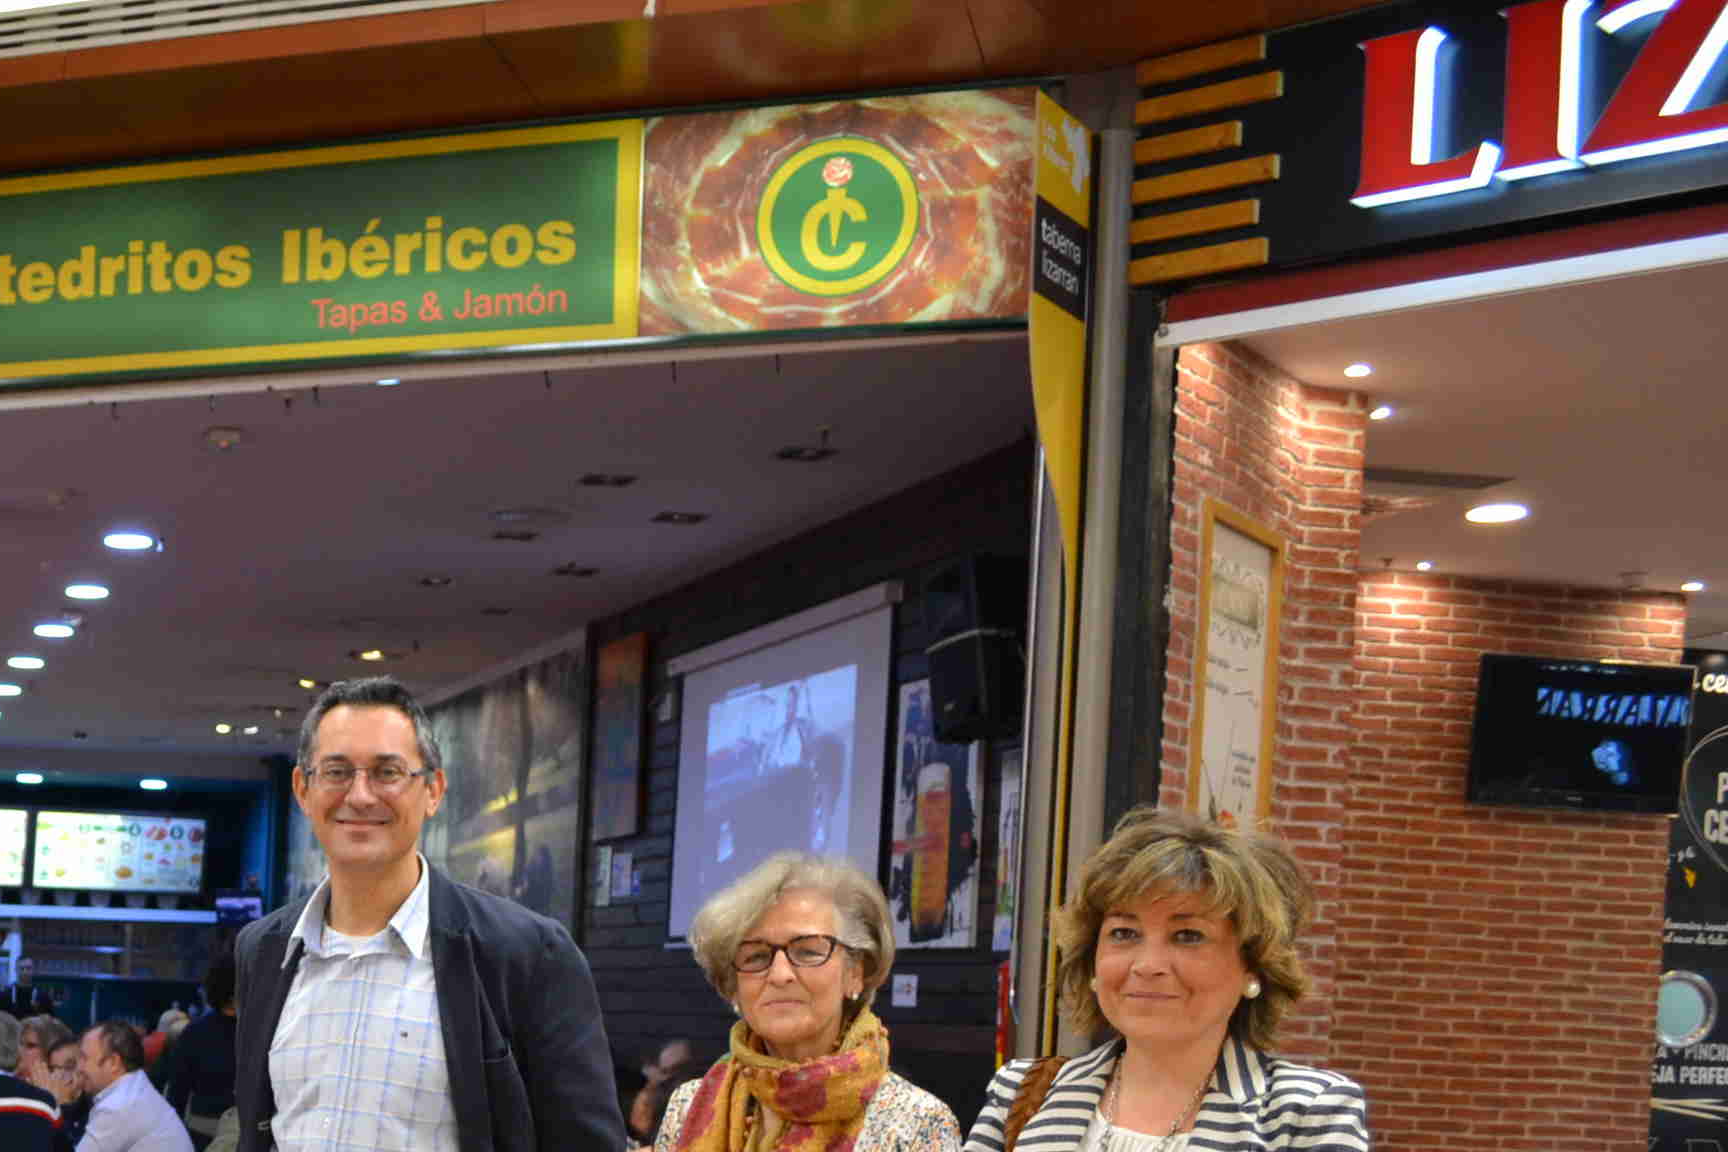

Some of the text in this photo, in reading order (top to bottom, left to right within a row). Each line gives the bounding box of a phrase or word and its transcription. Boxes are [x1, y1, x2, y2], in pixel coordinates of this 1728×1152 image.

[281, 216, 577, 284] Ibéricos
[310, 284, 569, 336] Tapas & Jamón
